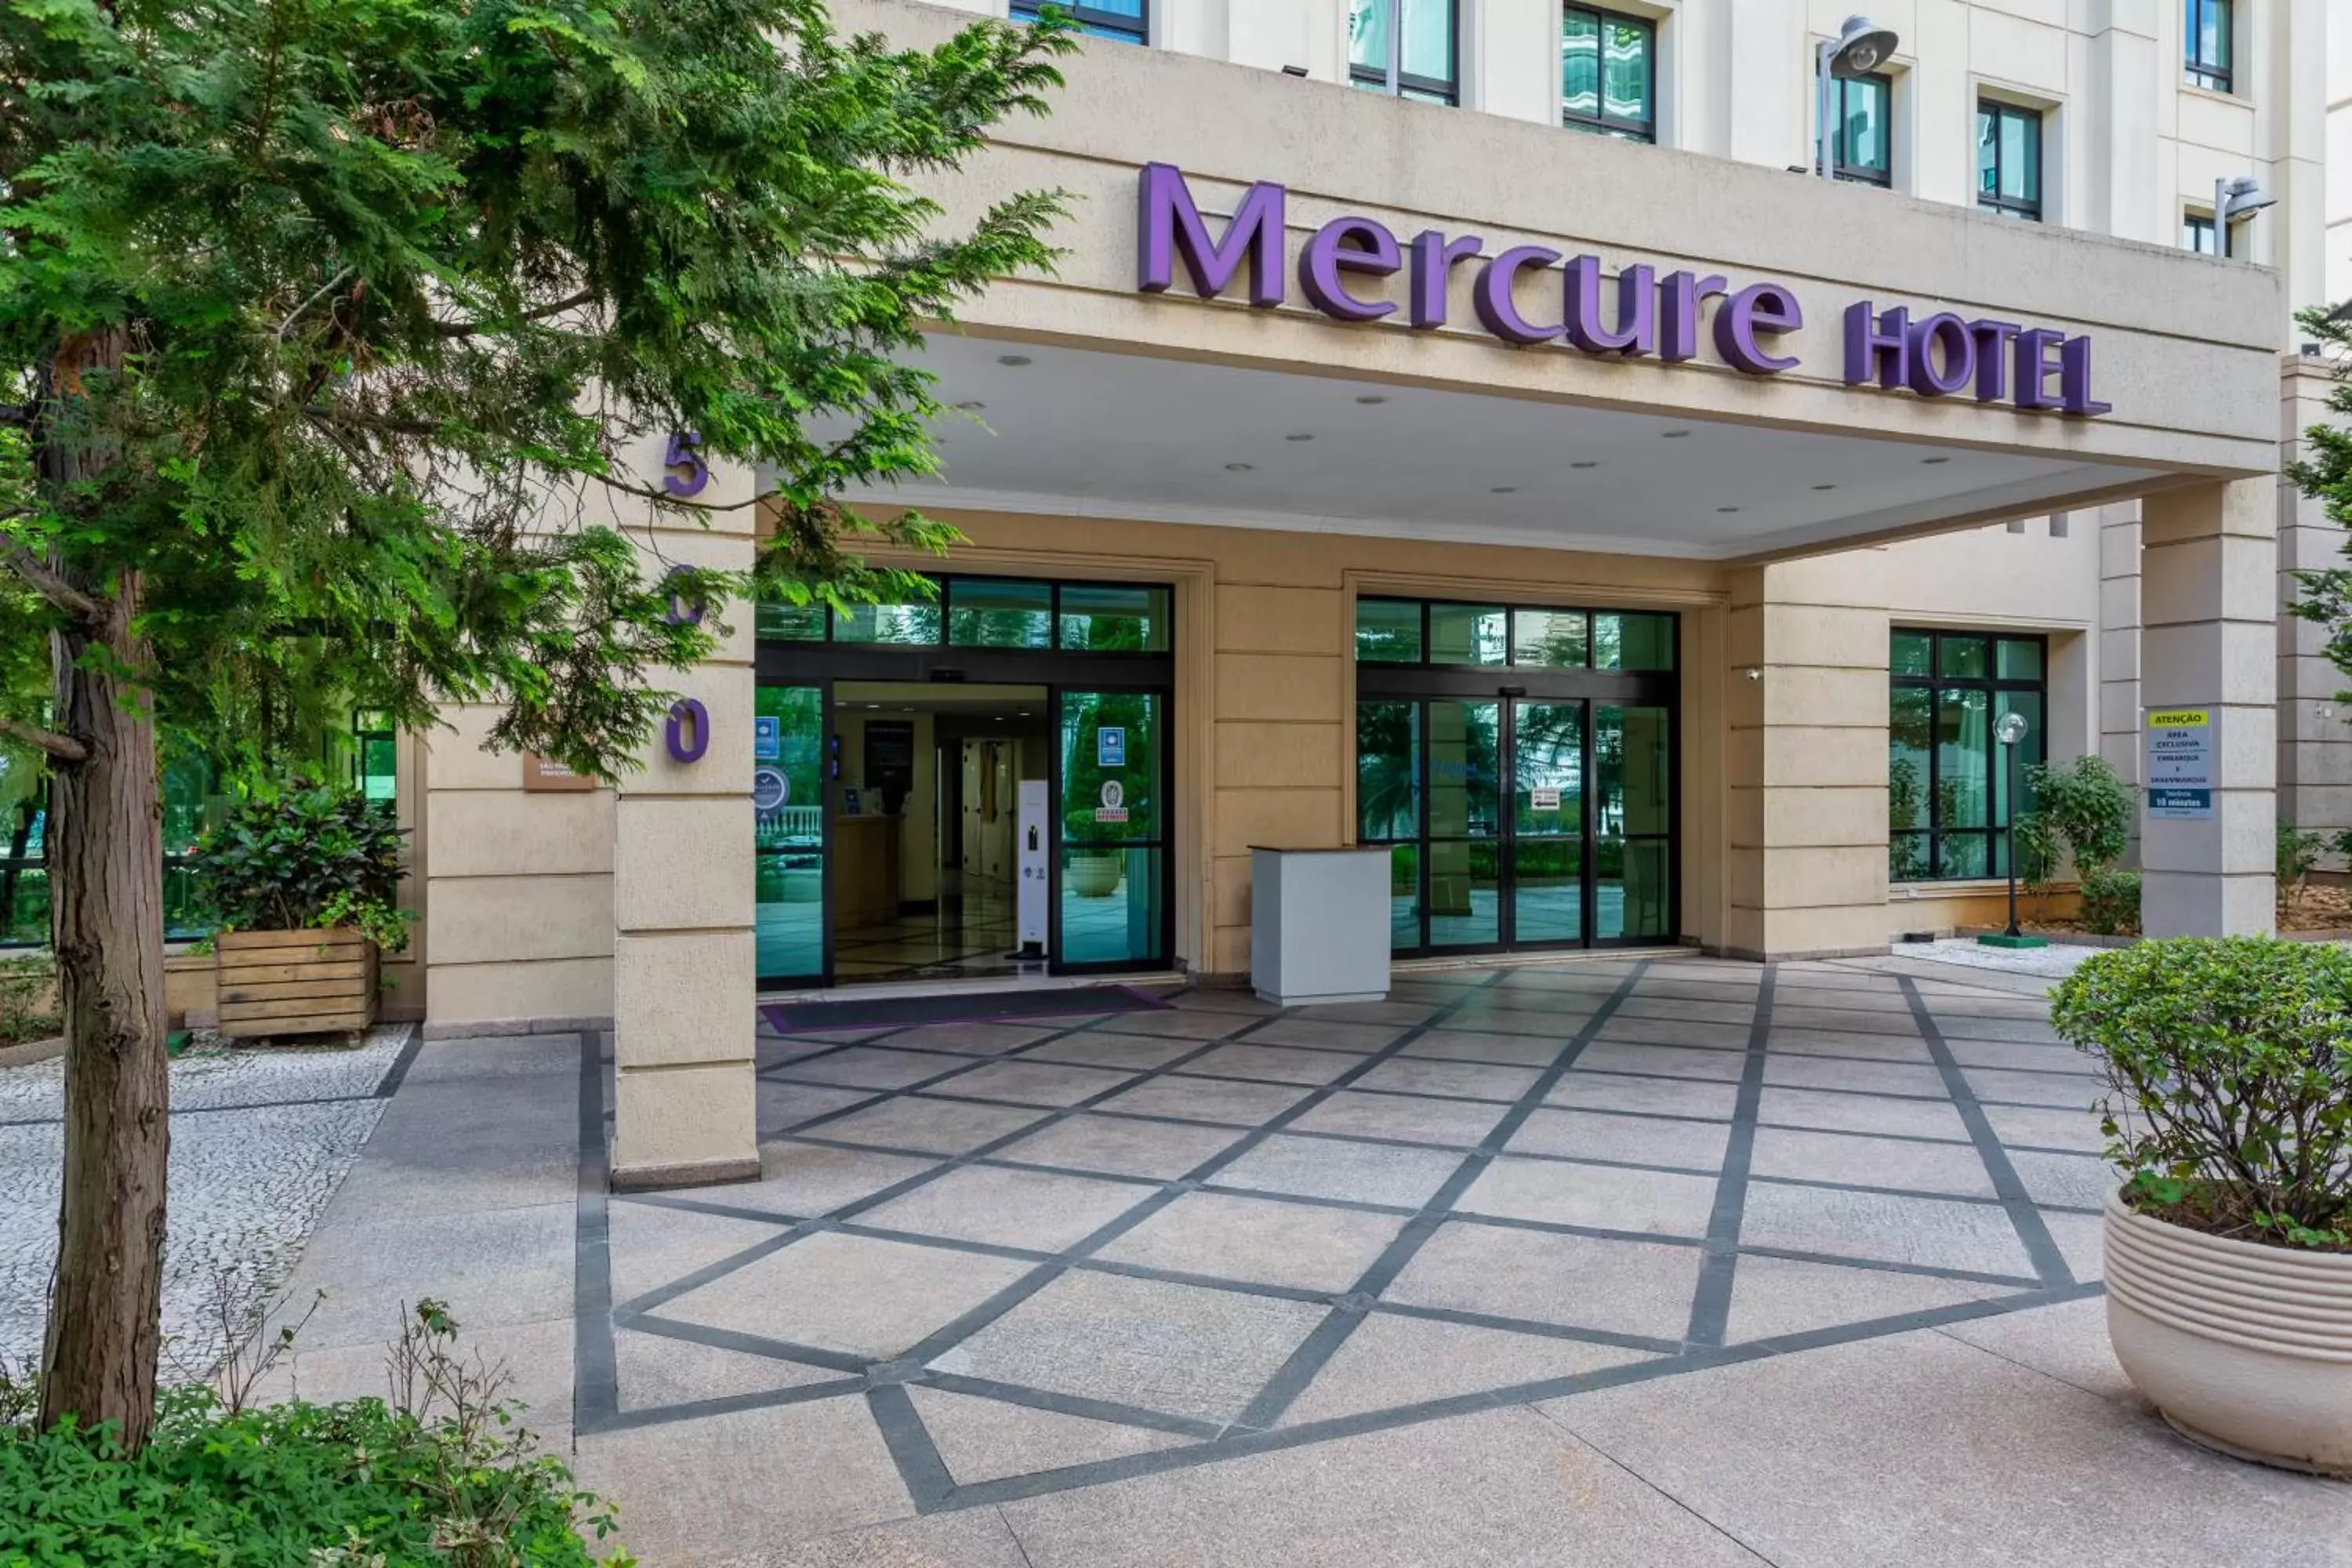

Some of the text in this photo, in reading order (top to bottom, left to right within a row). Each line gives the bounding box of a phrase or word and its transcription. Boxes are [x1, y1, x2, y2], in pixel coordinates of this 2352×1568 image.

[1138, 161, 2112, 416] Mercure HOTEL
[2155, 713, 2201, 724] ATENÇÃO
